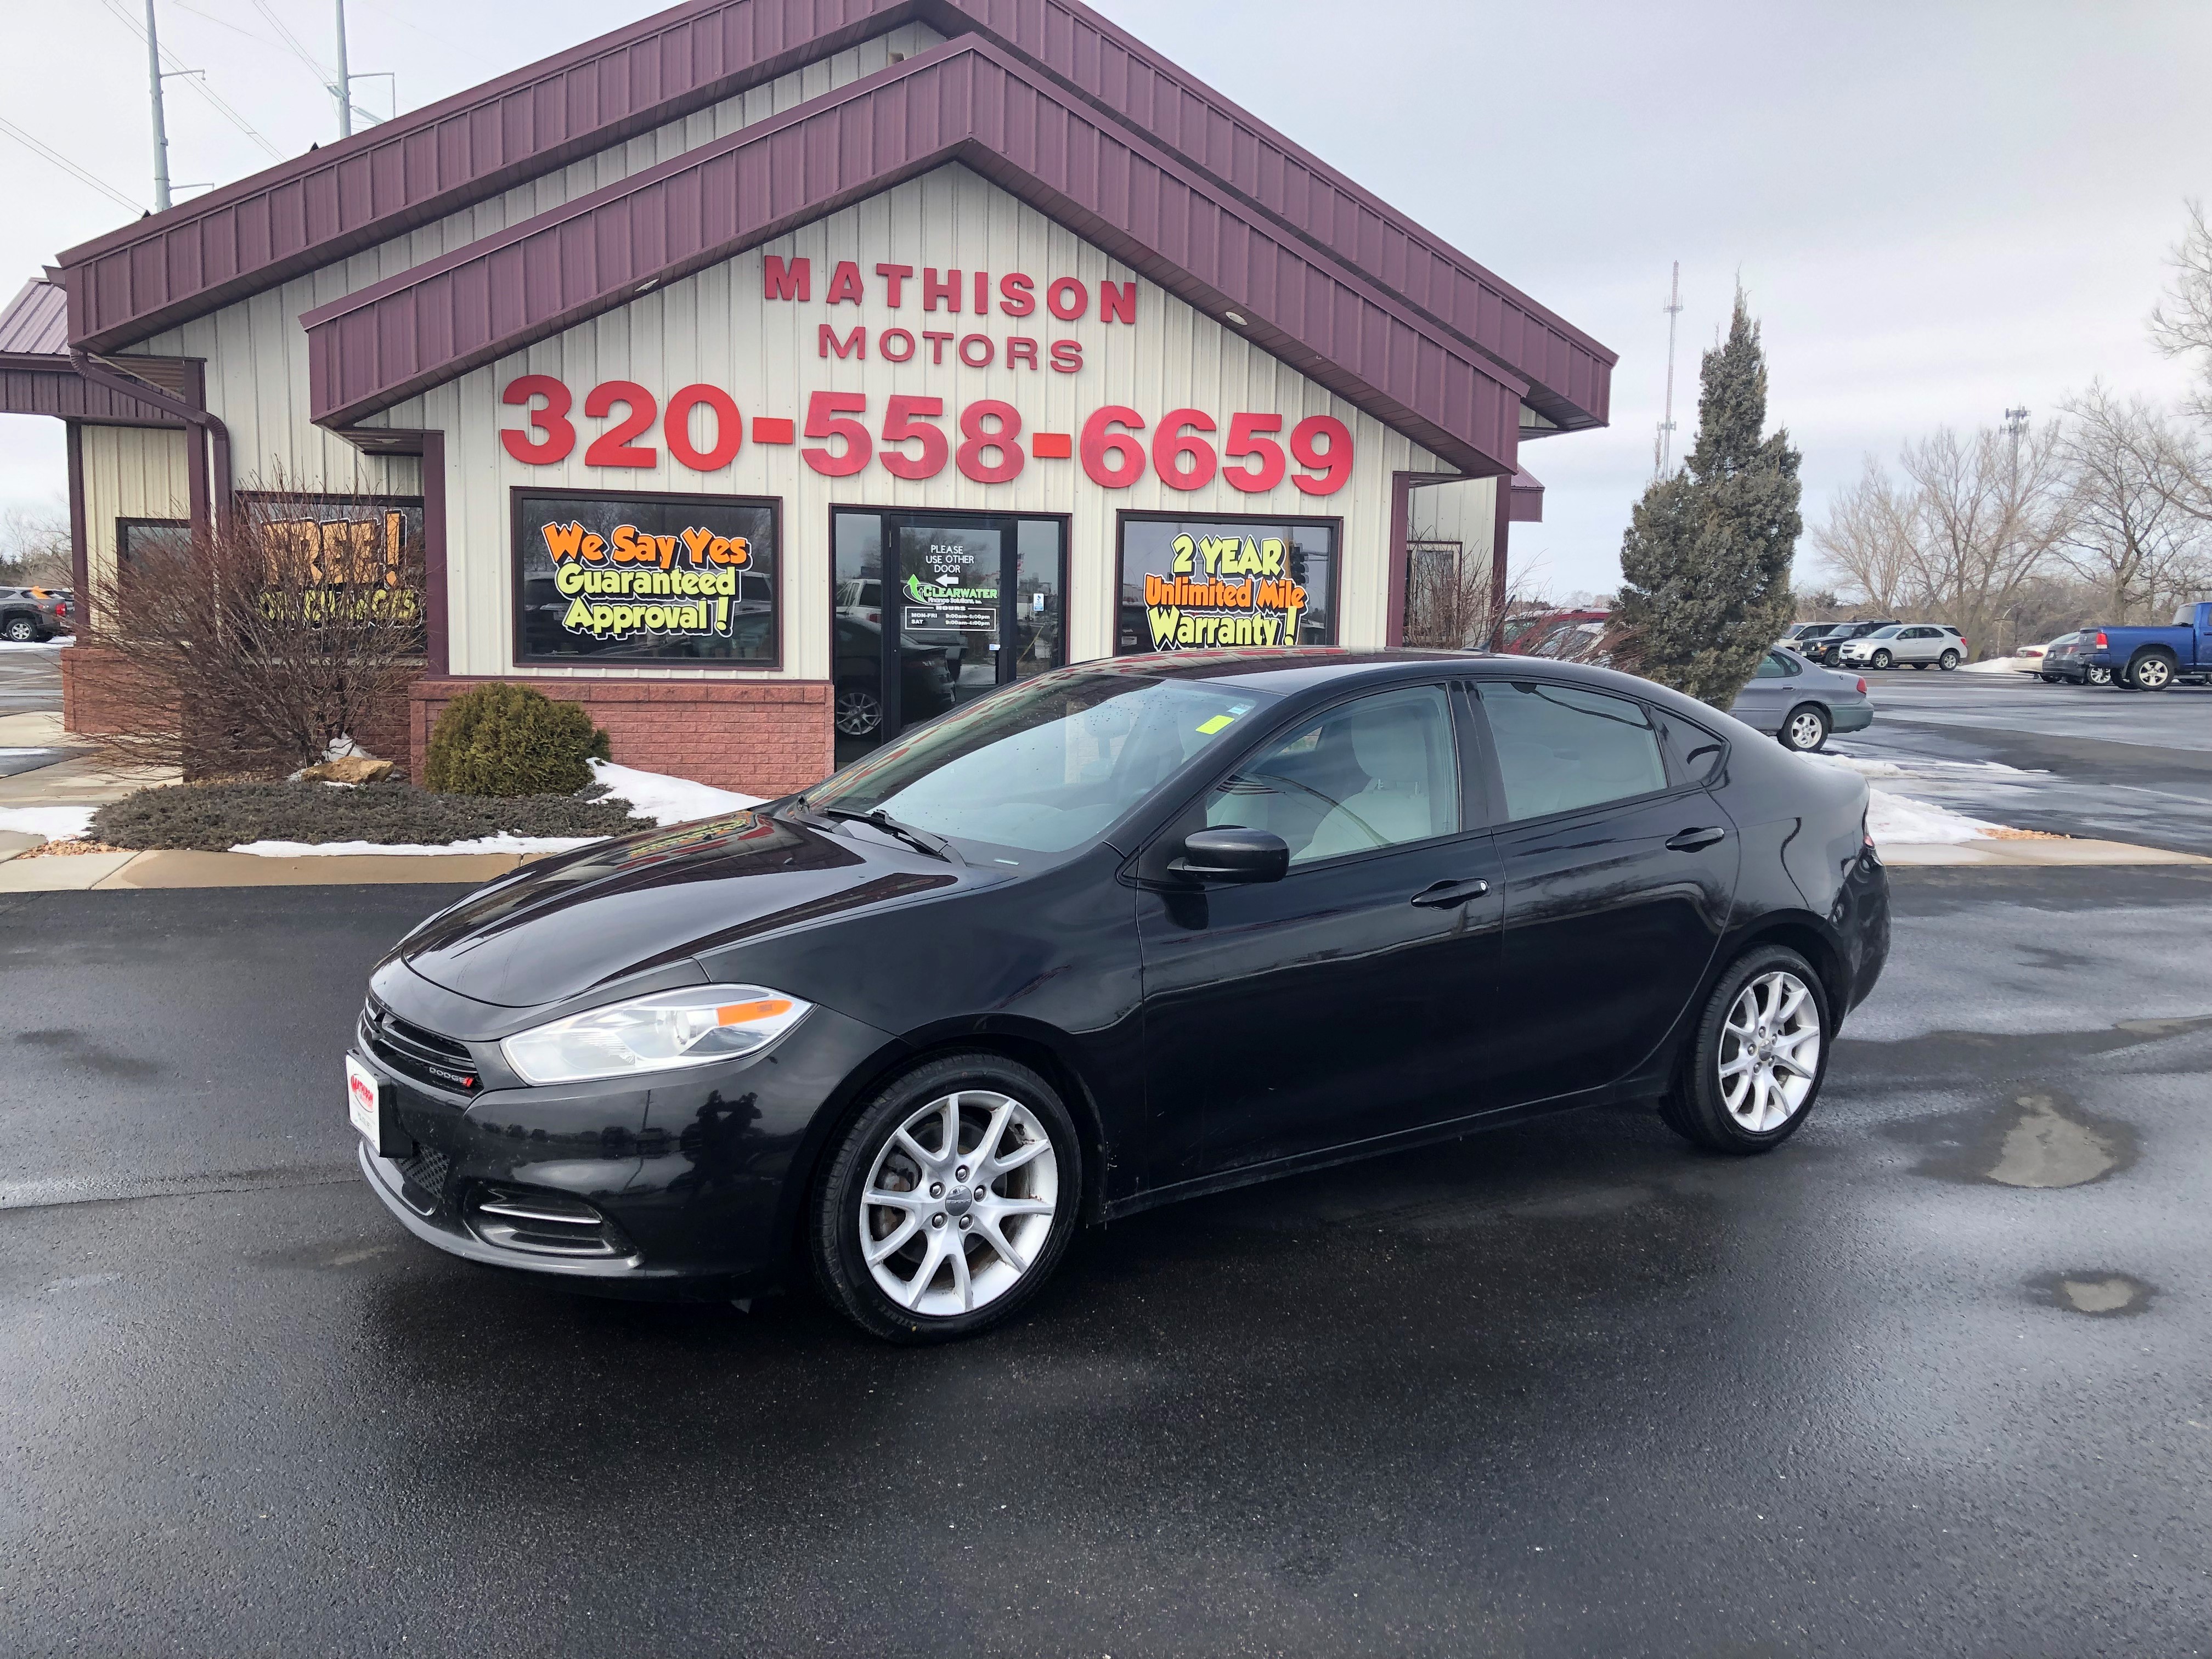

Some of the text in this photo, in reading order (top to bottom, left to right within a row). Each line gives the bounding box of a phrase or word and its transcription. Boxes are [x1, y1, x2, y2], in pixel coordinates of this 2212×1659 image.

[764, 255, 1136, 325] MATHISON
[819, 324, 1084, 374] MOTORS
[500, 374, 1354, 496] 320-558-6659
[542, 522, 748, 569] We Say Yes
[926, 555, 974, 564] USE OTHER
[930, 544, 963, 555] PLEASE
[1172, 534, 1283, 576] 2 YEAR
[556, 562, 736, 596] Guaranteed
[934, 564, 961, 573] DOOR
[1145, 574, 1306, 610] Unlimited Mile
[429, 1066, 467, 1084] DODGE
